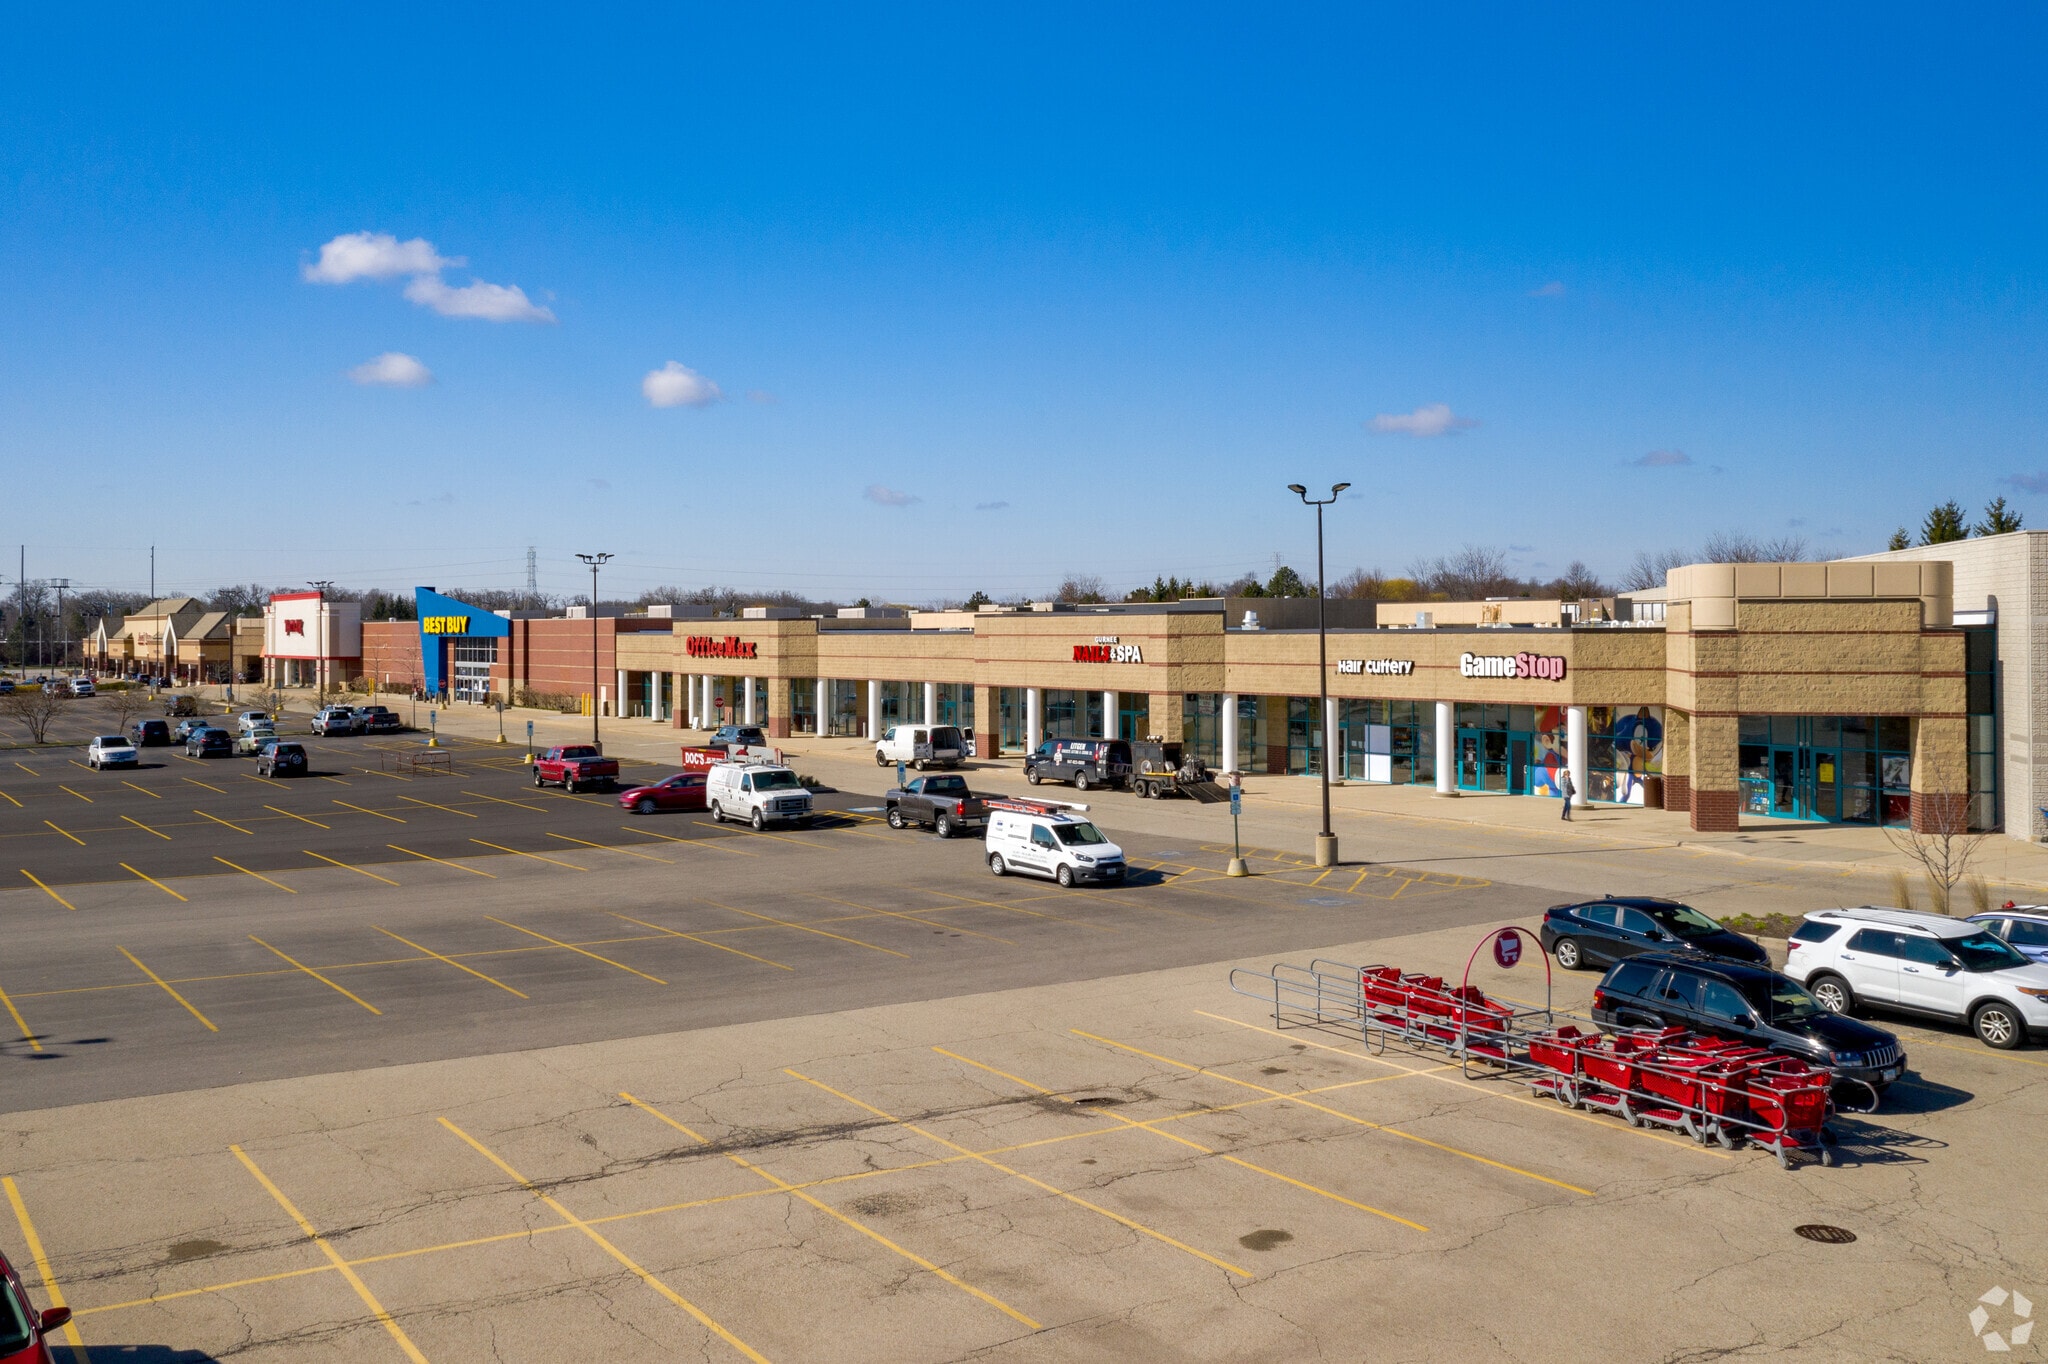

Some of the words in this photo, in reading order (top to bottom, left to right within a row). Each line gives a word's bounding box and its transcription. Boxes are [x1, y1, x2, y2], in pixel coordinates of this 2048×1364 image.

[423, 616, 446, 634] BEST
[446, 616, 468, 634] BUY
[686, 635, 756, 658] OfficeMax
[1073, 645, 1111, 663] NAILS
[1117, 645, 1143, 663] SPA
[1338, 660, 1364, 674] Hair
[1460, 652, 1566, 681] GameStop
[684, 752, 705, 765] DOC'S
